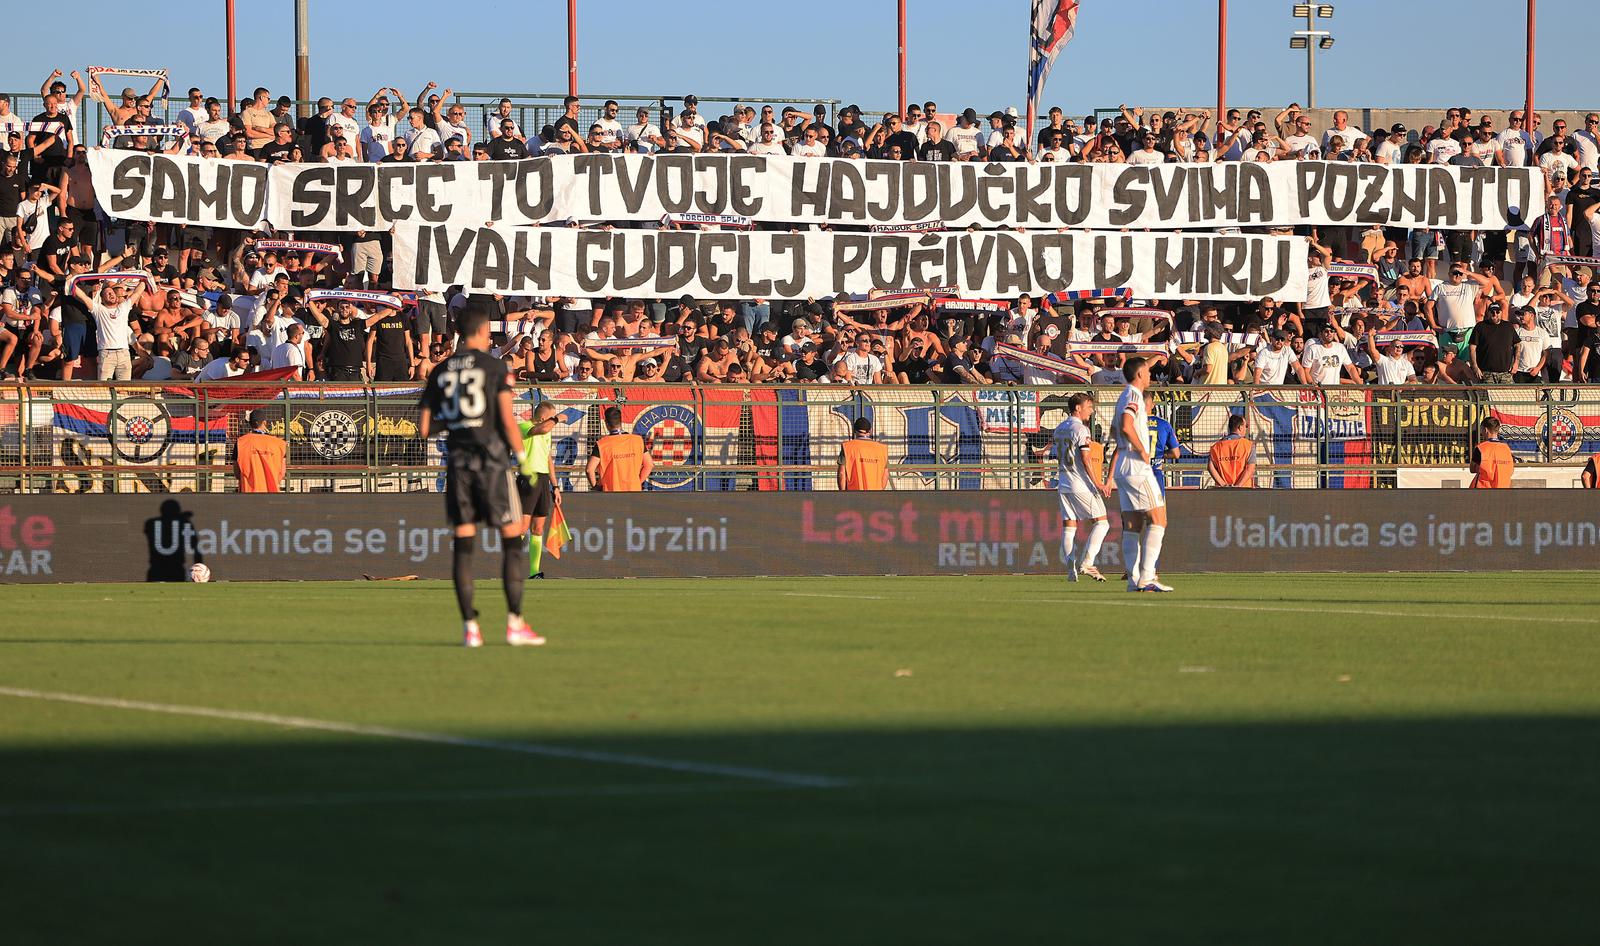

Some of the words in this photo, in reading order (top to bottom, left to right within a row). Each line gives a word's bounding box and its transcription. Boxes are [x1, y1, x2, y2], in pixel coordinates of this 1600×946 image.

[111, 127, 183, 135] HAJDUK
[111, 155, 268, 227] SAMO
[291, 163, 455, 228] SRCE
[478, 157, 554, 221] TO
[574, 155, 767, 216] TVOJE
[792, 162, 1093, 225] HAJDUČKO
[1109, 162, 1273, 225] SVIMA
[1297, 161, 1530, 226] POZNATO
[680, 213, 716, 222] TORCIDA
[721, 215, 747, 224] SPLIT
[877, 223, 911, 232] HAJDUK
[308, 243, 334, 252] ULTRAS
[415, 225, 552, 290] IVAN
[576, 231, 806, 297] GUDELJ
[833, 233, 1073, 294] POČIVAO
[1094, 234, 1132, 289] U
[1155, 237, 1290, 296] MIRU
[945, 301, 975, 310] HAJDUK
[437, 368, 487, 419] 33
[314, 412, 353, 428] HAJDUK
[802, 500, 919, 543] Last
[154, 519, 334, 555] Utakmica
[345, 527, 387, 554] se
[627, 518, 728, 552] brzini
[1209, 514, 1370, 548] Utakmica
[1379, 521, 1418, 547] se
[1428, 514, 1493, 554] igra
[1504, 522, 1522, 546] u
[1534, 521, 1600, 555] pun
[938, 542, 1020, 567] RENT
[1029, 542, 1049, 567] A
